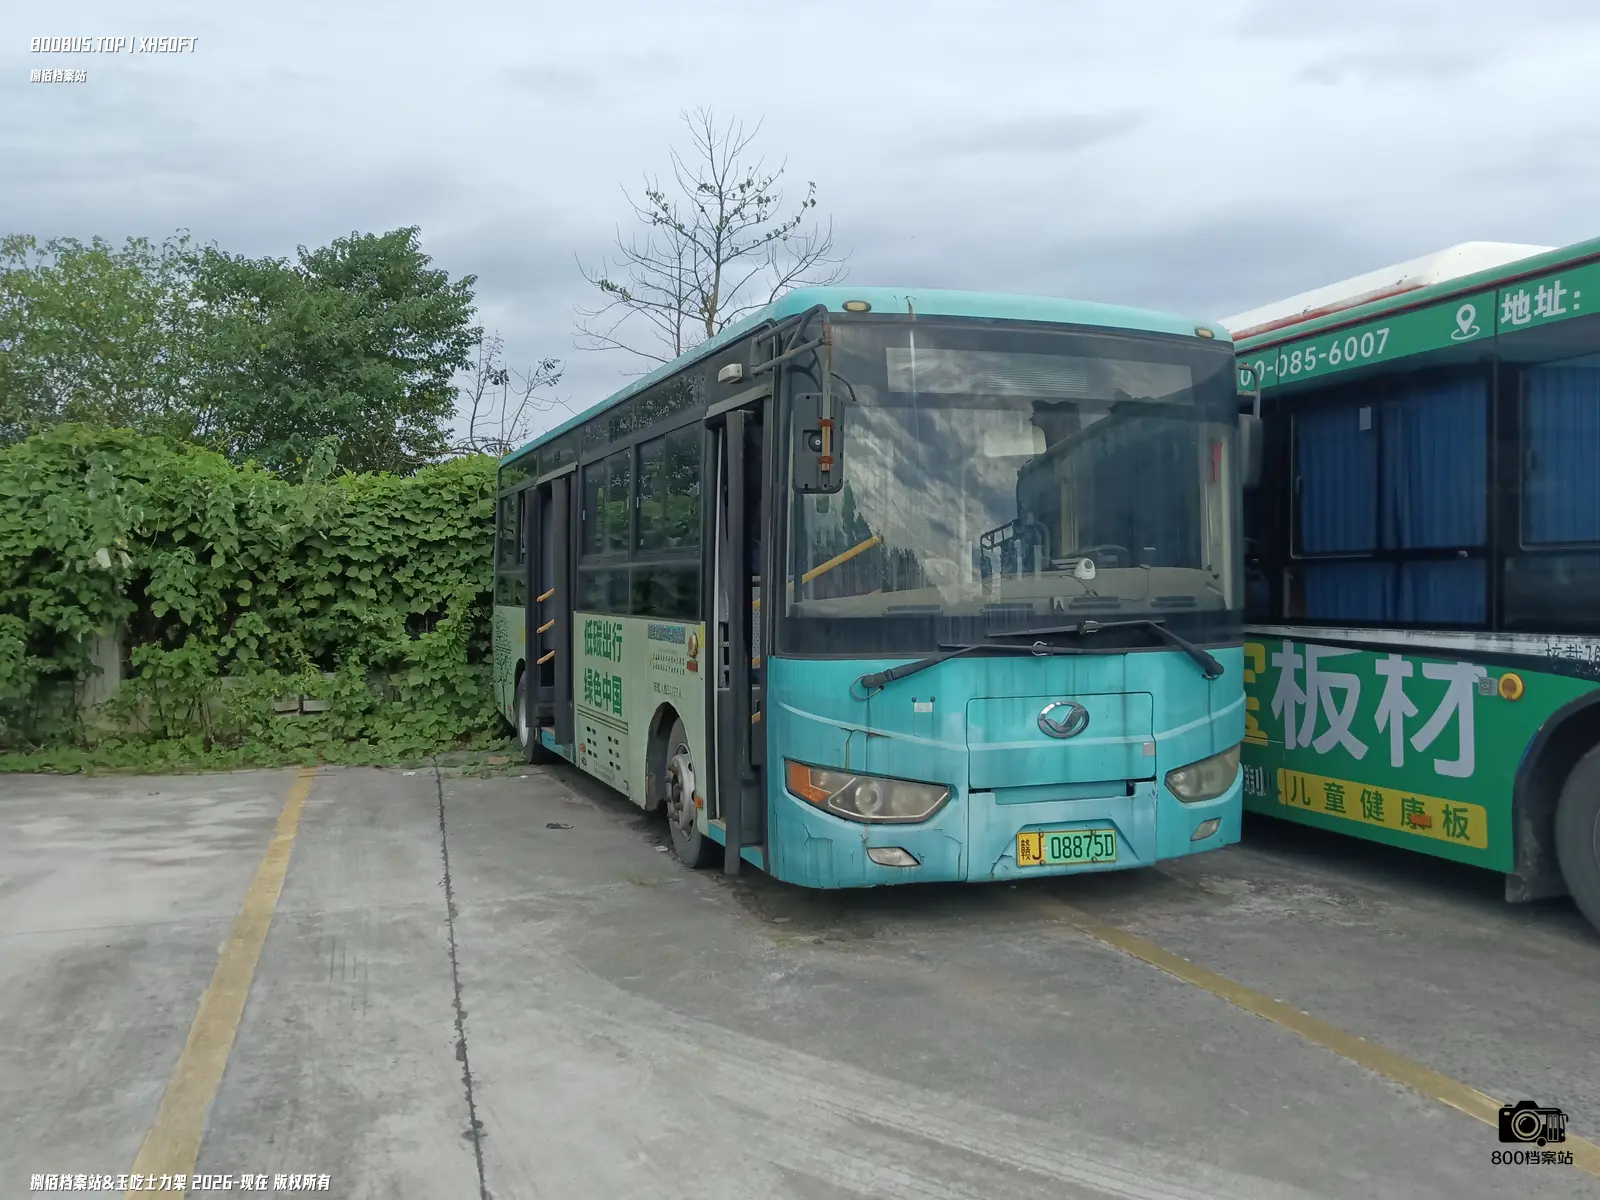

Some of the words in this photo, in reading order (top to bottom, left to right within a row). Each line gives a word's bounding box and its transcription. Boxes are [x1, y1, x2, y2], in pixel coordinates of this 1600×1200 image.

[584, 619, 623, 663] 低碳出行
[584, 667, 623, 717] 绿色中国
